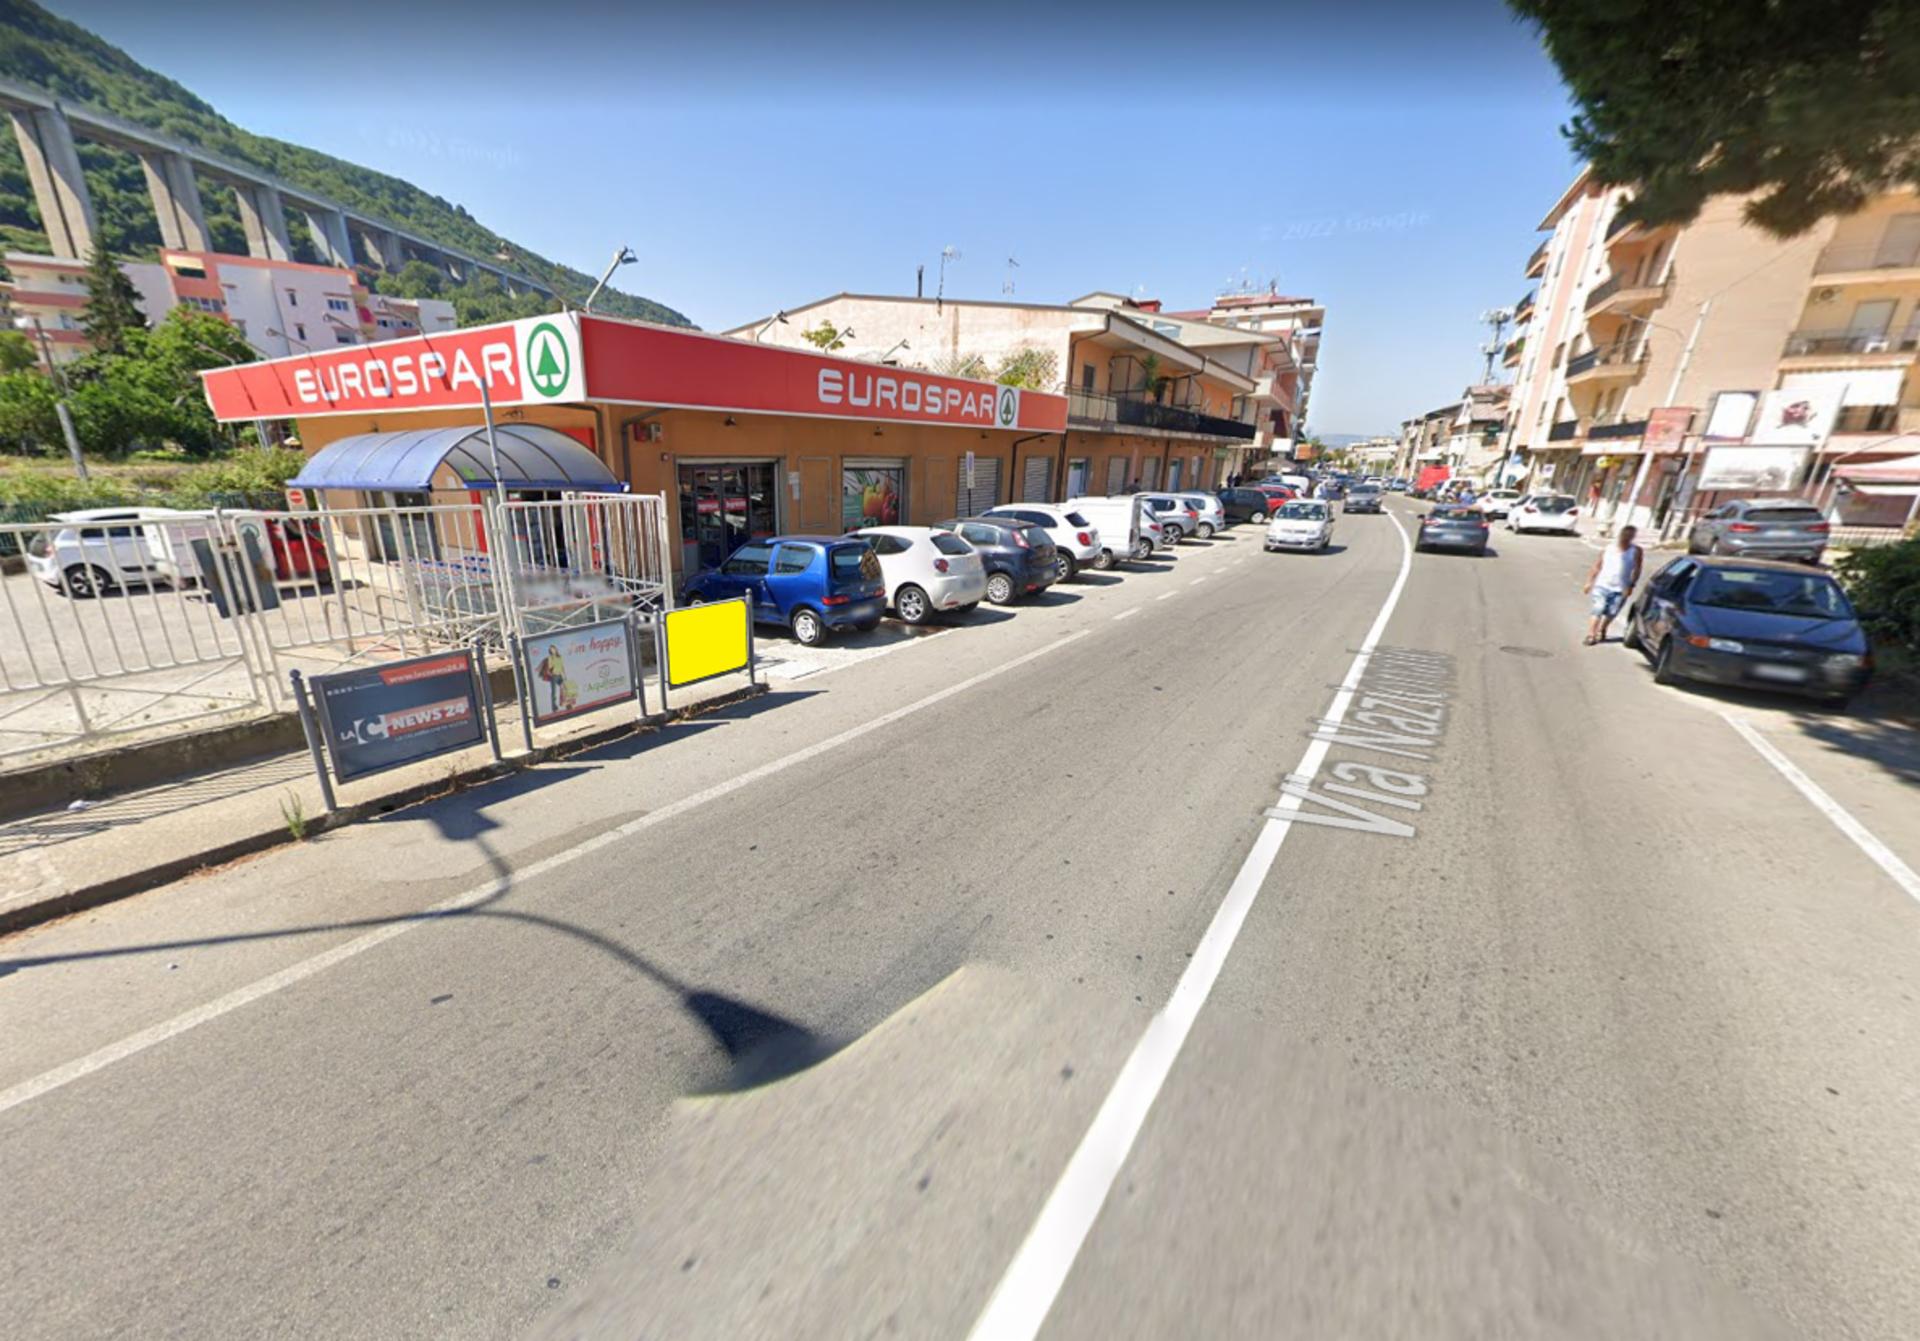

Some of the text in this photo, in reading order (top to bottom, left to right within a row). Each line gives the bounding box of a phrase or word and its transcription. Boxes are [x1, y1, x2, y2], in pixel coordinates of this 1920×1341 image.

[294, 342, 516, 403] EUROSPAR
[818, 368, 995, 419] EUROSPAR
[391, 708, 443, 731] NEWS
[445, 702, 468, 718] 24
